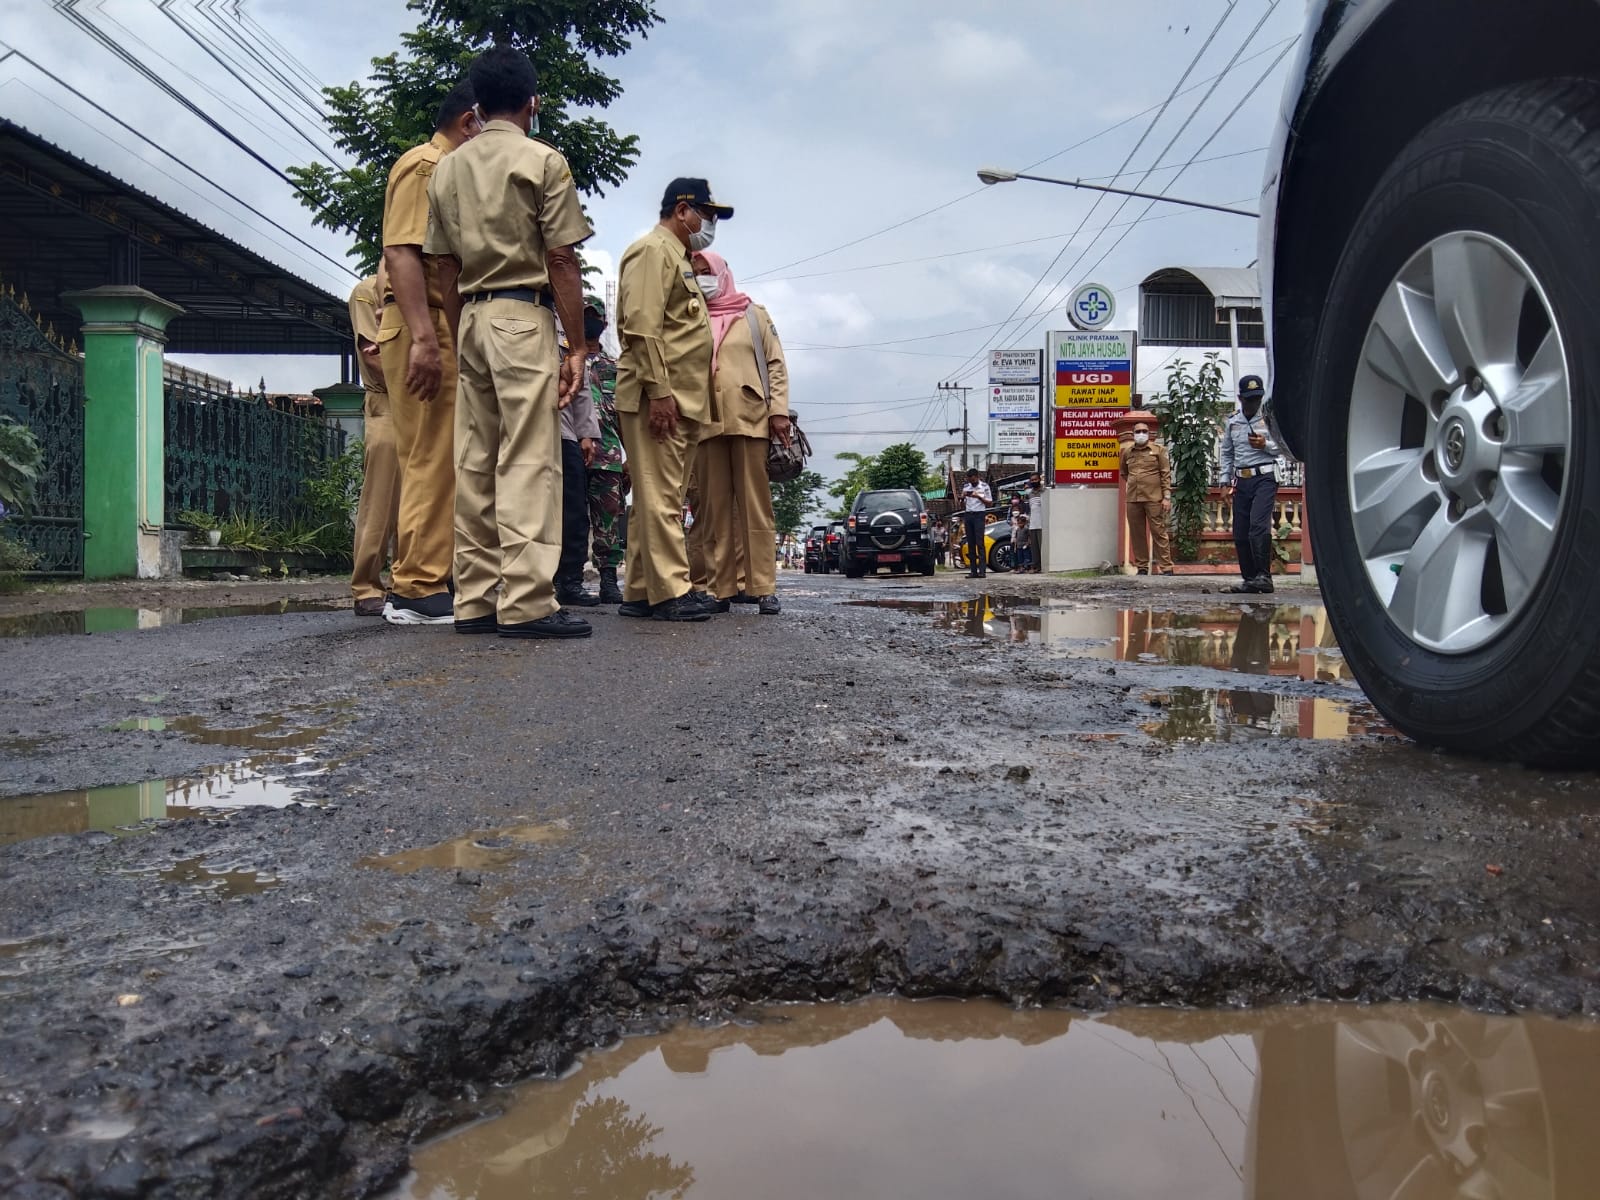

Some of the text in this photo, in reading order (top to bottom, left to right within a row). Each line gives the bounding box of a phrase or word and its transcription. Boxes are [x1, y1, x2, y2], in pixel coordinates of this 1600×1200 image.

[1060, 342, 1127, 358] NITA JAYA HUSADA
[1071, 373, 1113, 384] UGD
